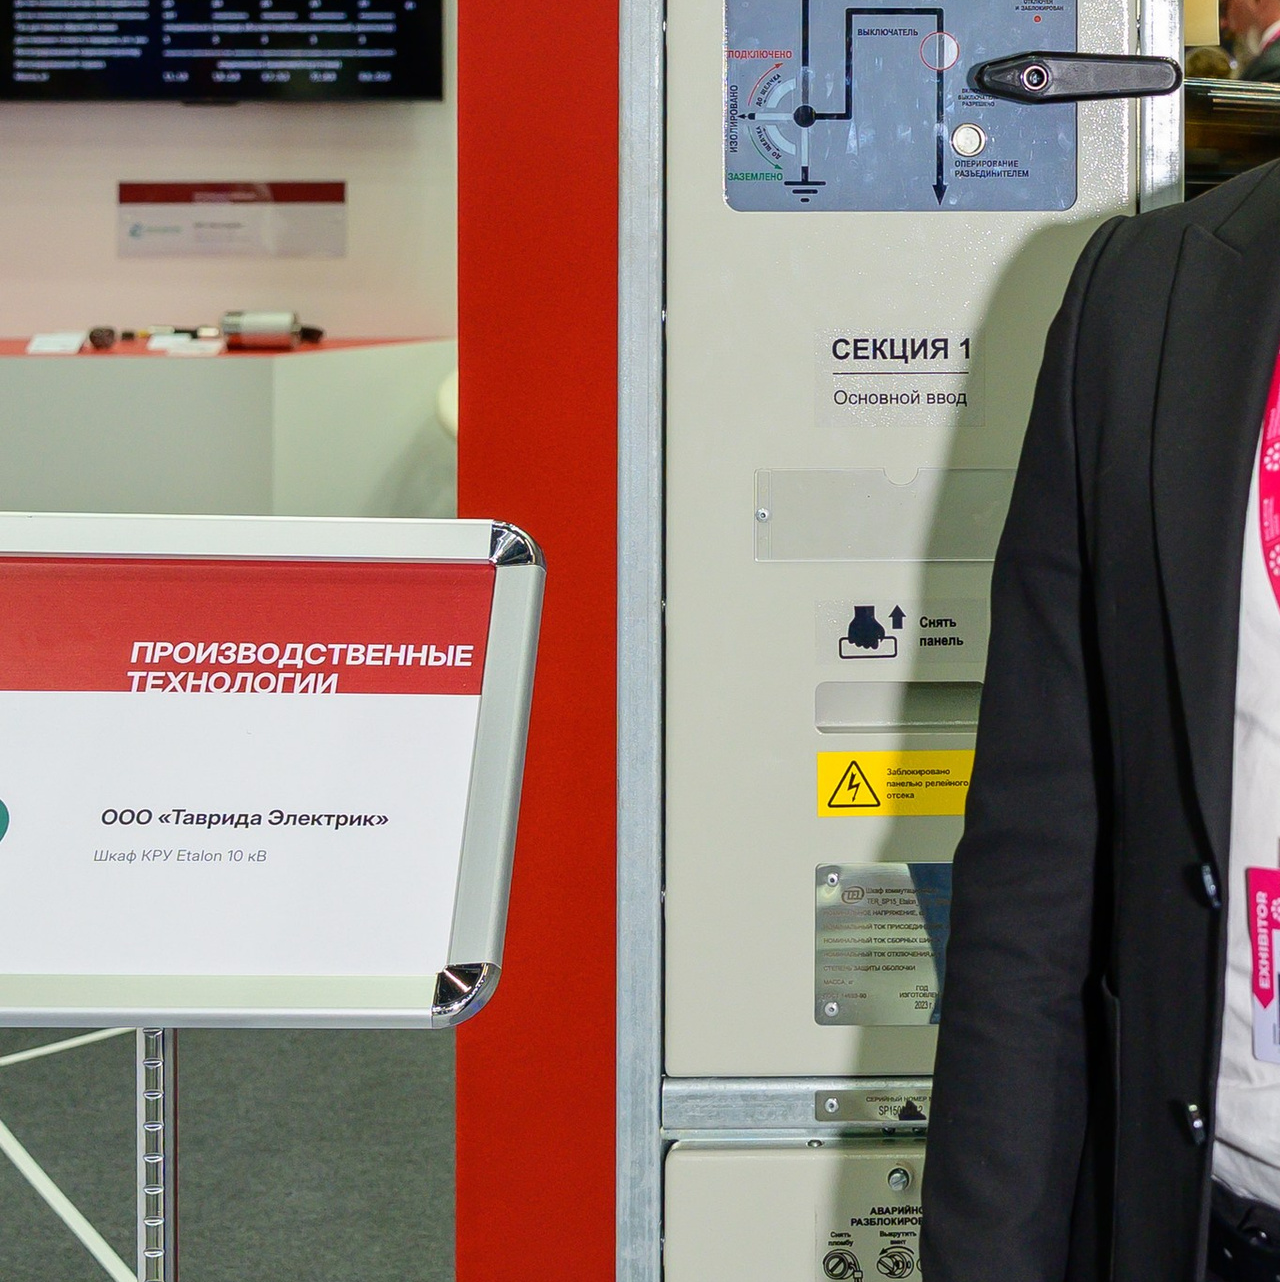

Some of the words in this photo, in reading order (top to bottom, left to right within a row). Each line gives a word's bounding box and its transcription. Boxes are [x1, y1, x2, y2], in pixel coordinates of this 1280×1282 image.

[857, 28, 919, 36] ВЫКЛЮЧАТЕЛЬ
[727, 50, 793, 59] ПОДКЛЮЧЕНО
[729, 84, 739, 153] ИЗОЛИРОВАНО
[727, 172, 784, 181] ЗАЗЕМЛЕНО
[954, 170, 1029, 179] РАЗЪЕДИНИТЕЛЕМ
[832, 338, 949, 364] СЕКЦИЯ
[959, 338, 970, 359] 1
[833, 390, 920, 405] Основной
[926, 392, 968, 407] ввод
[920, 616, 957, 628] Снять
[920, 637, 964, 646] панель
[130, 641, 475, 668] ПРОИЗВОДСТВЕННЫЕ
[127, 670, 339, 694] ТЕХНОЛОГИИ
[886, 768, 951, 777] Заблокировано
[925, 779, 969, 788] релейного
[101, 808, 153, 825] ООО
[158, 808, 262, 829] «Таврида
[267, 809, 389, 830] Электрик»
[93, 849, 137, 864] Шкаф
[141, 849, 174, 862] КРУ
[176, 849, 222, 862] Etalon
[227, 849, 244, 862] 10
[248, 849, 267, 862] кВ
[865, 887, 884, 895] Шкаф
[824, 936, 872, 944] НОМИНАЛЬНЫЙ
[1255, 891, 1271, 990] EXHIBITOR
[853, 964, 880, 972] ЗАЩИТЫ
[915, 1000, 928, 1010] 2023
[880, 1231, 917, 1239] Выкрутить
